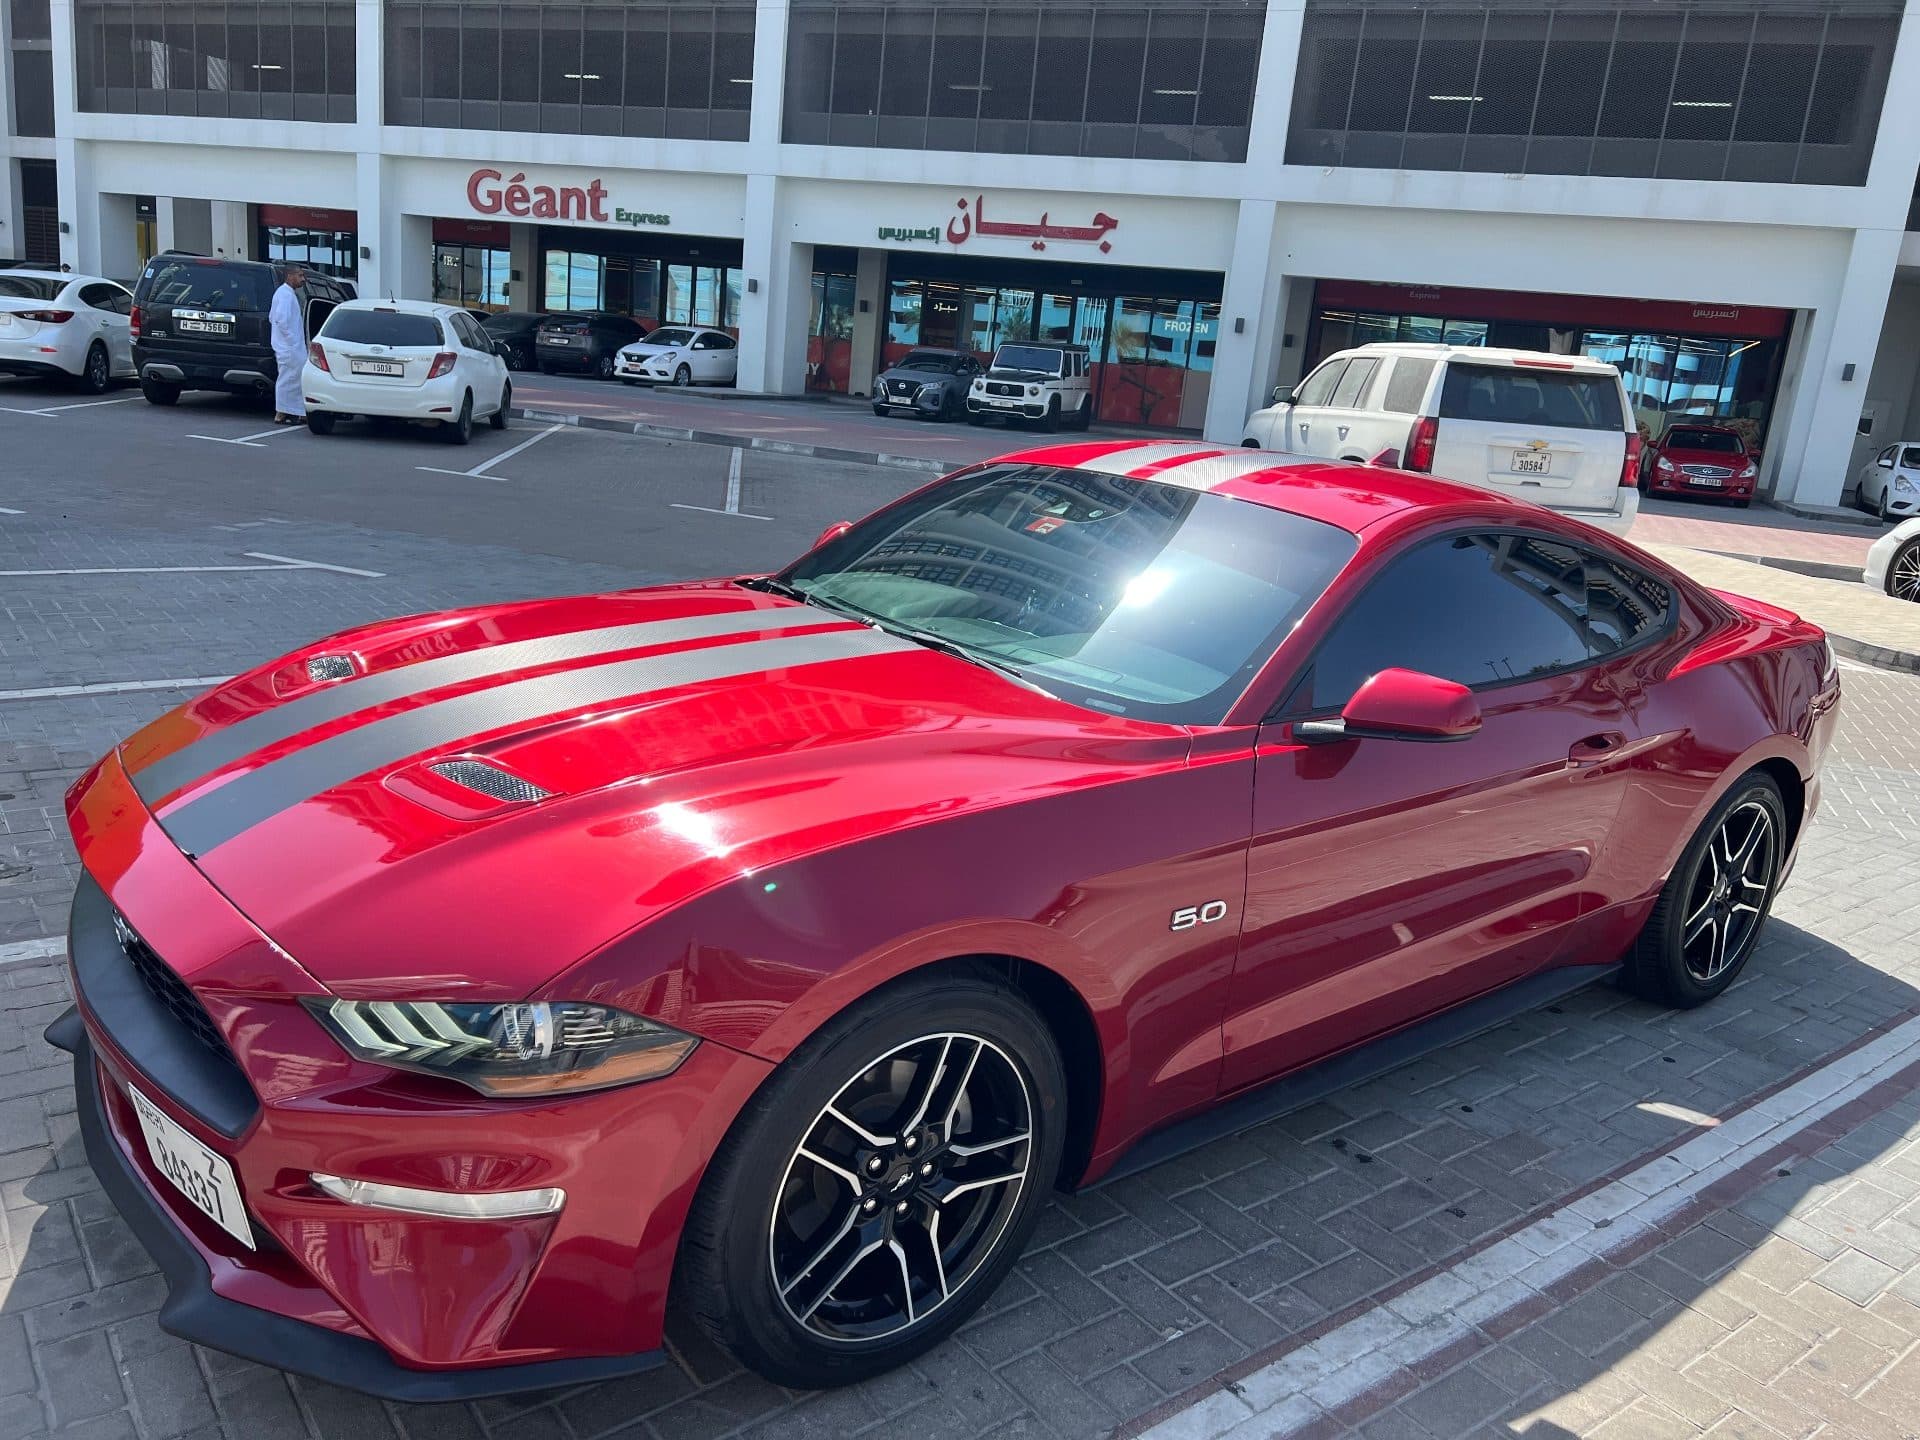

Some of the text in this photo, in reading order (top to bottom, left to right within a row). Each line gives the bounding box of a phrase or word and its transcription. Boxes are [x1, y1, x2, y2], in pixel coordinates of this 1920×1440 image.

[466, 168, 671, 227] Géant Express
[182, 321, 188, 329] H
[203, 322, 228, 332] 75669
[1164, 320, 1209, 334] FROZEN
[1518, 460, 1543, 472] 30584
[156, 1137, 225, 1223] 84337
